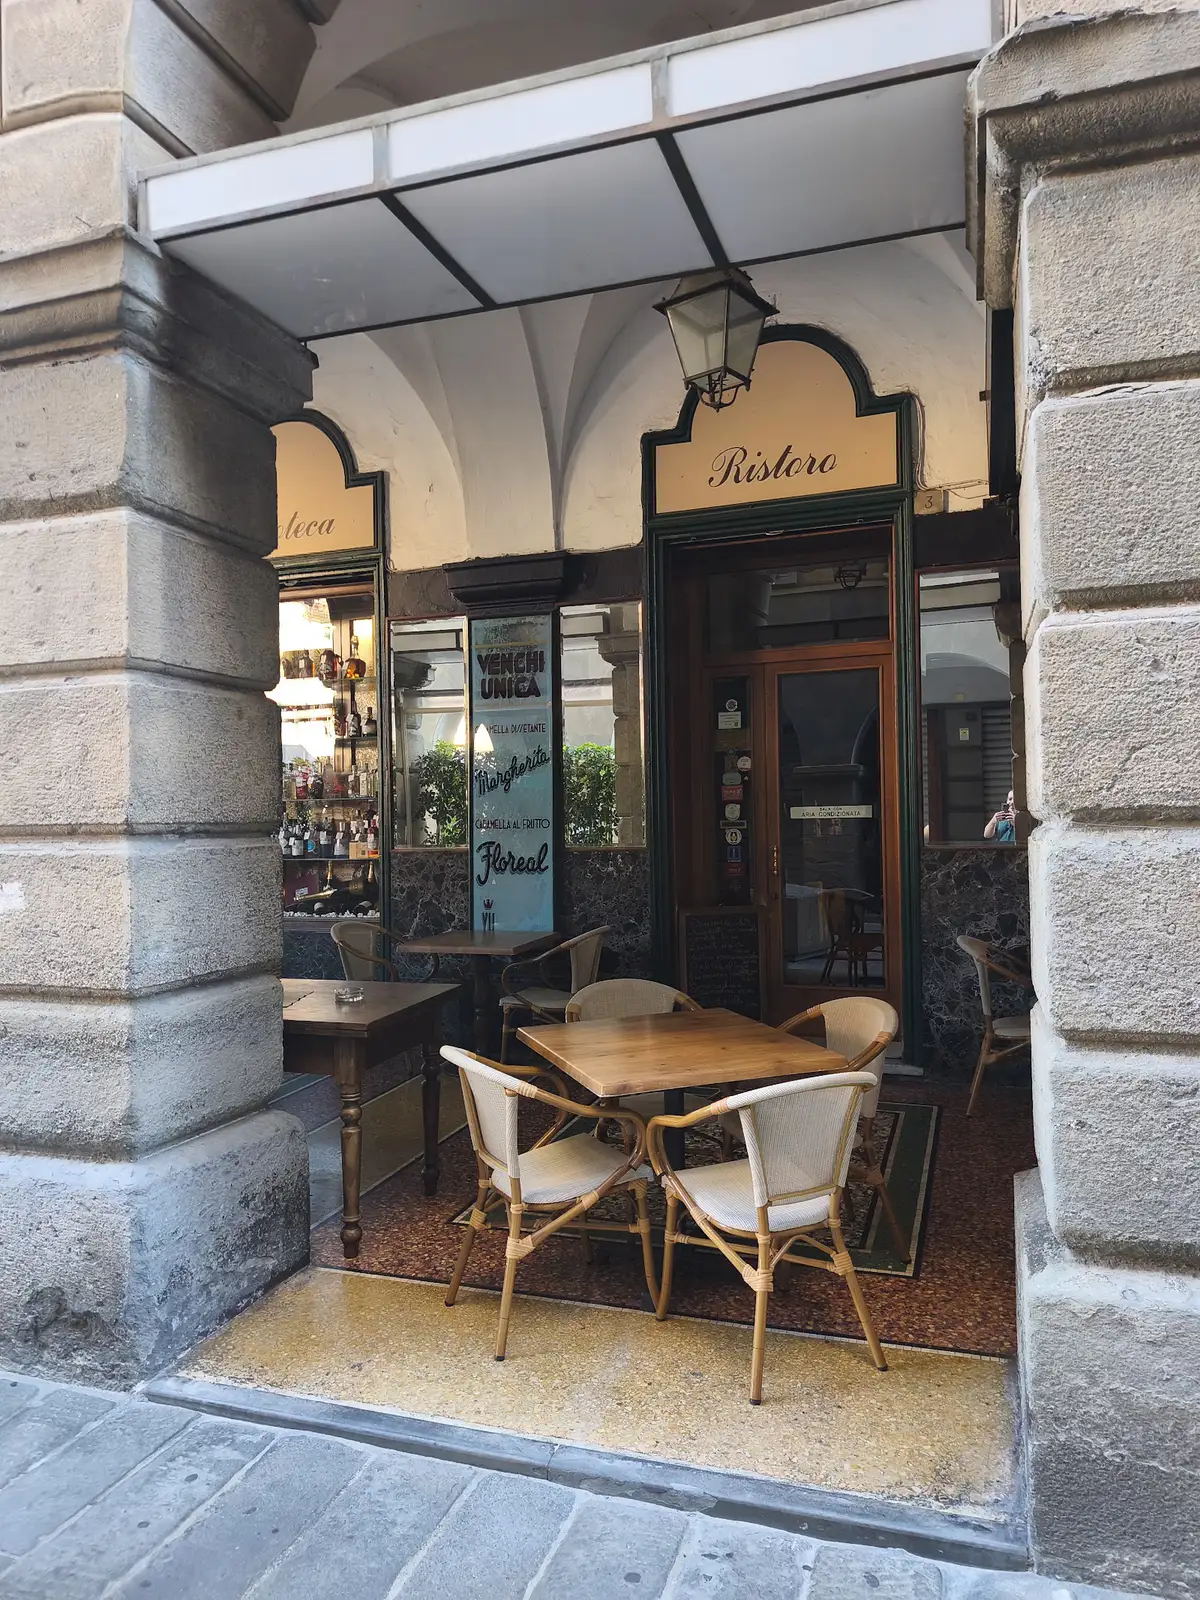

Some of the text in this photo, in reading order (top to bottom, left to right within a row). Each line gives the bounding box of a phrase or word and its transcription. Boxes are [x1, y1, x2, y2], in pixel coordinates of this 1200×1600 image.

[708, 444, 838, 487] Ristoro
[924, 495, 934, 509] 3
[477, 650, 545, 675] VENCHI
[480, 676, 541, 700] UNICA
[474, 724, 510, 734] CAMELLA
[474, 744, 550, 798] Margherita
[512, 819, 521, 830] AL
[522, 818, 551, 830] FRUTTO
[475, 841, 549, 887] Floreal
